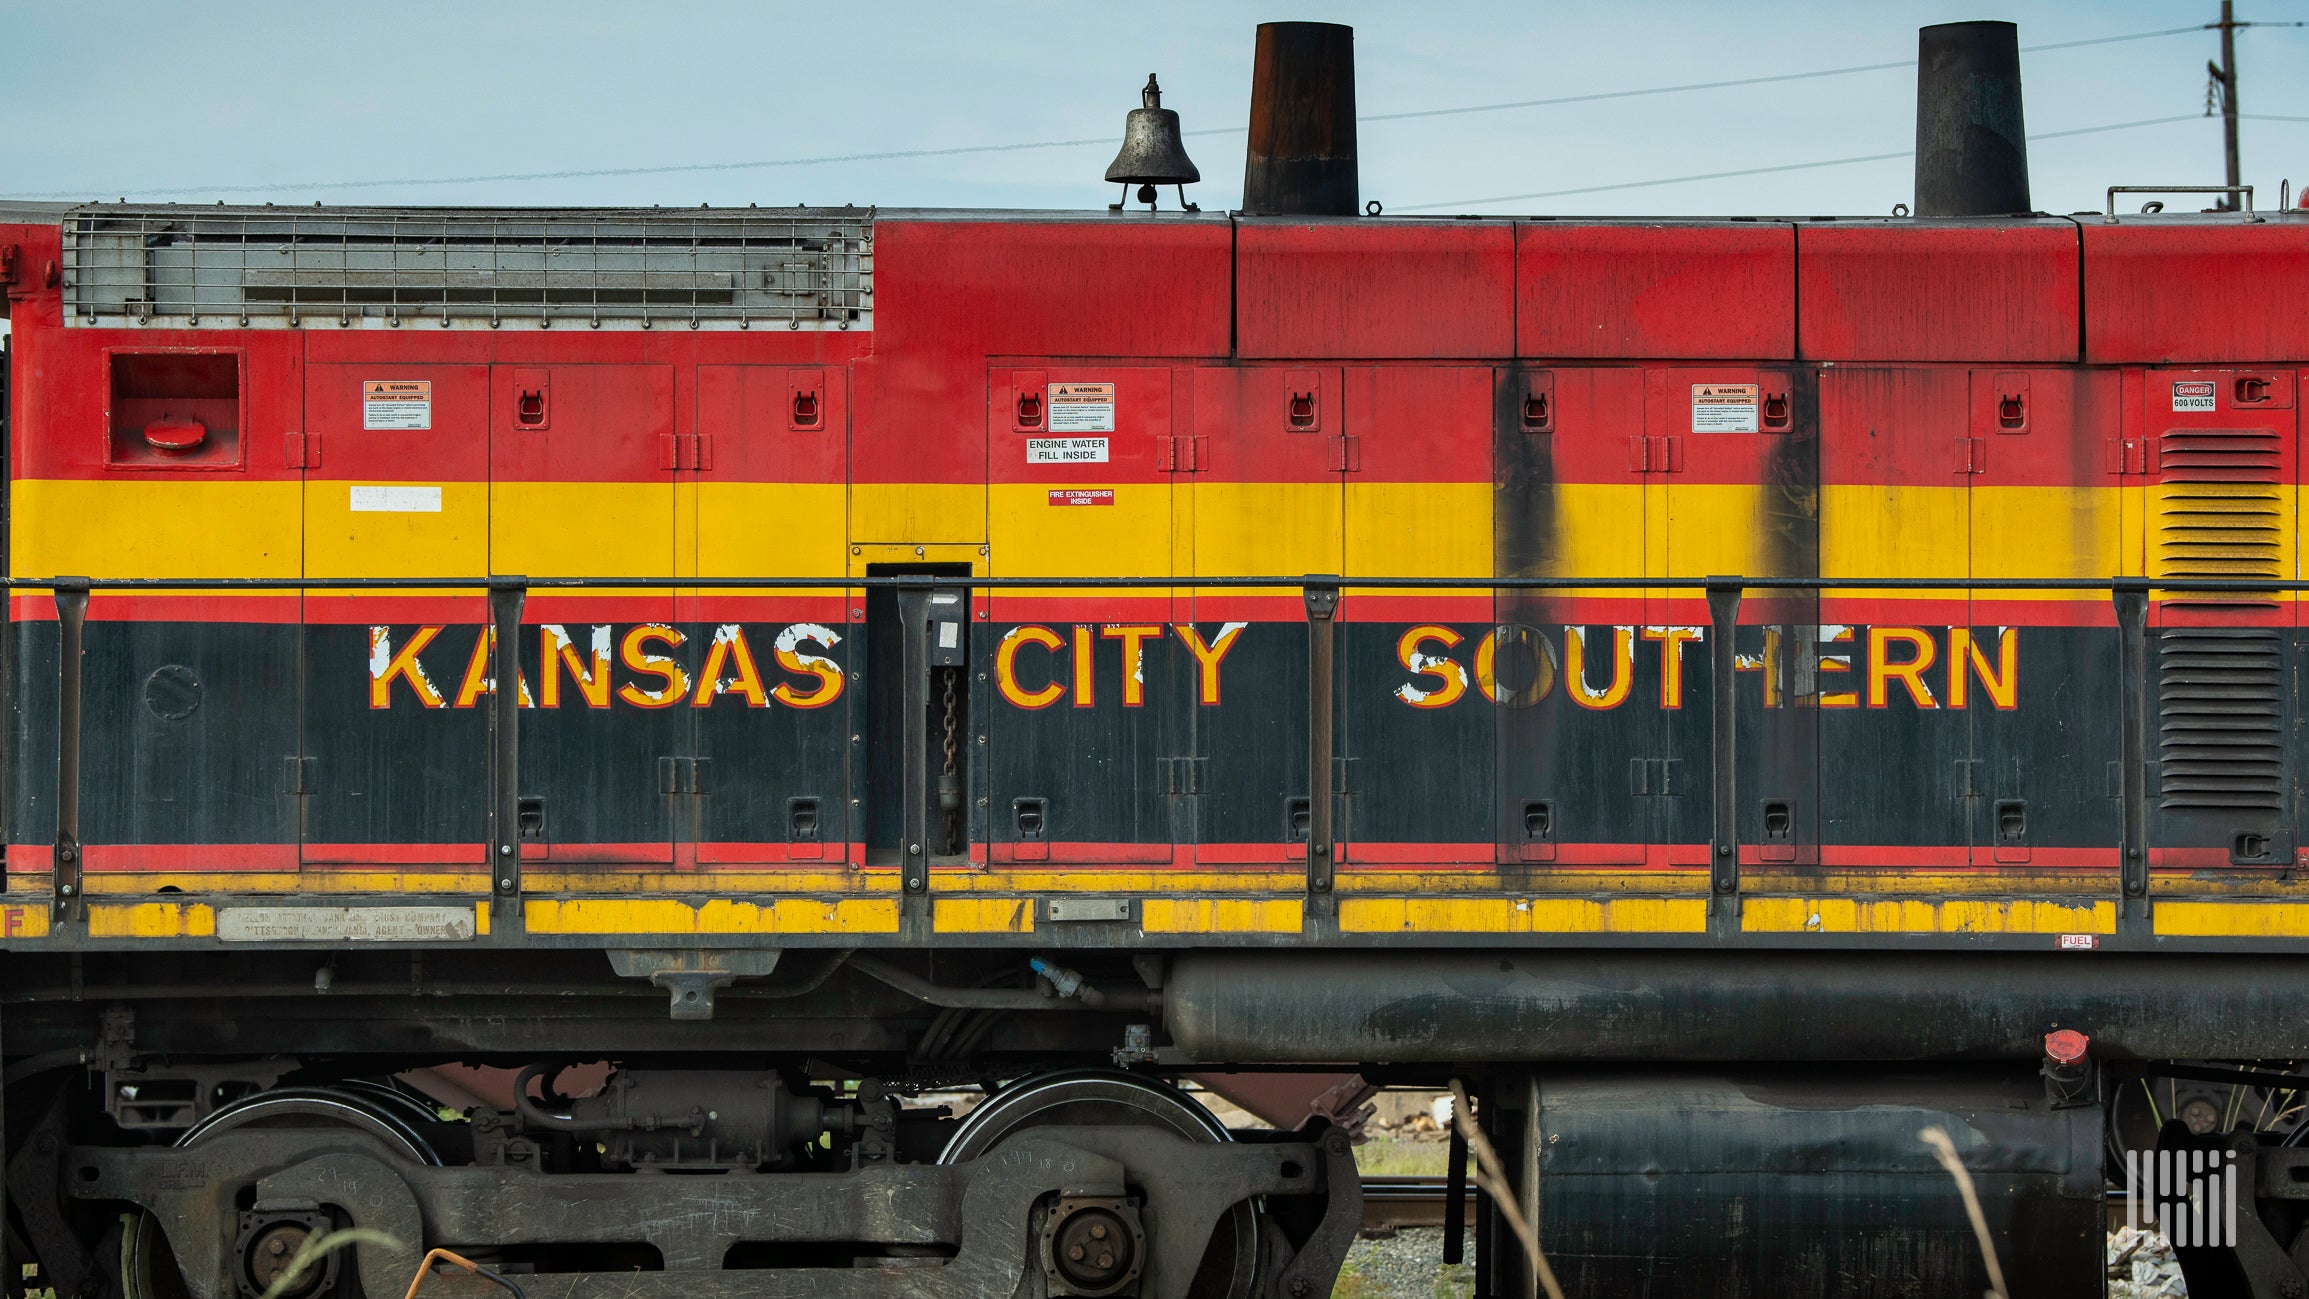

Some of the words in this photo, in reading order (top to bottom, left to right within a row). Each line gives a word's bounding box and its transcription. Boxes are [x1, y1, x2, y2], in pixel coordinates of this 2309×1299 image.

[2178, 386, 2210, 394] DANGER
[2174, 399, 2188, 407] 600
[2189, 398, 2214, 407] VOLTS
[1029, 440, 1067, 449] ENGINE
[1072, 439, 1105, 448] WATER
[1038, 451, 1059, 460] FILL
[1063, 451, 1097, 460] INSIDE
[1065, 490, 1113, 498] EXTINGUISHER
[369, 622, 845, 710] KANSAS
[995, 621, 1248, 710] CITY
[1395, 623, 2019, 710] SOUTHERN
[5, 909, 24, 938] F
[2063, 935, 2090, 945] FUEL
